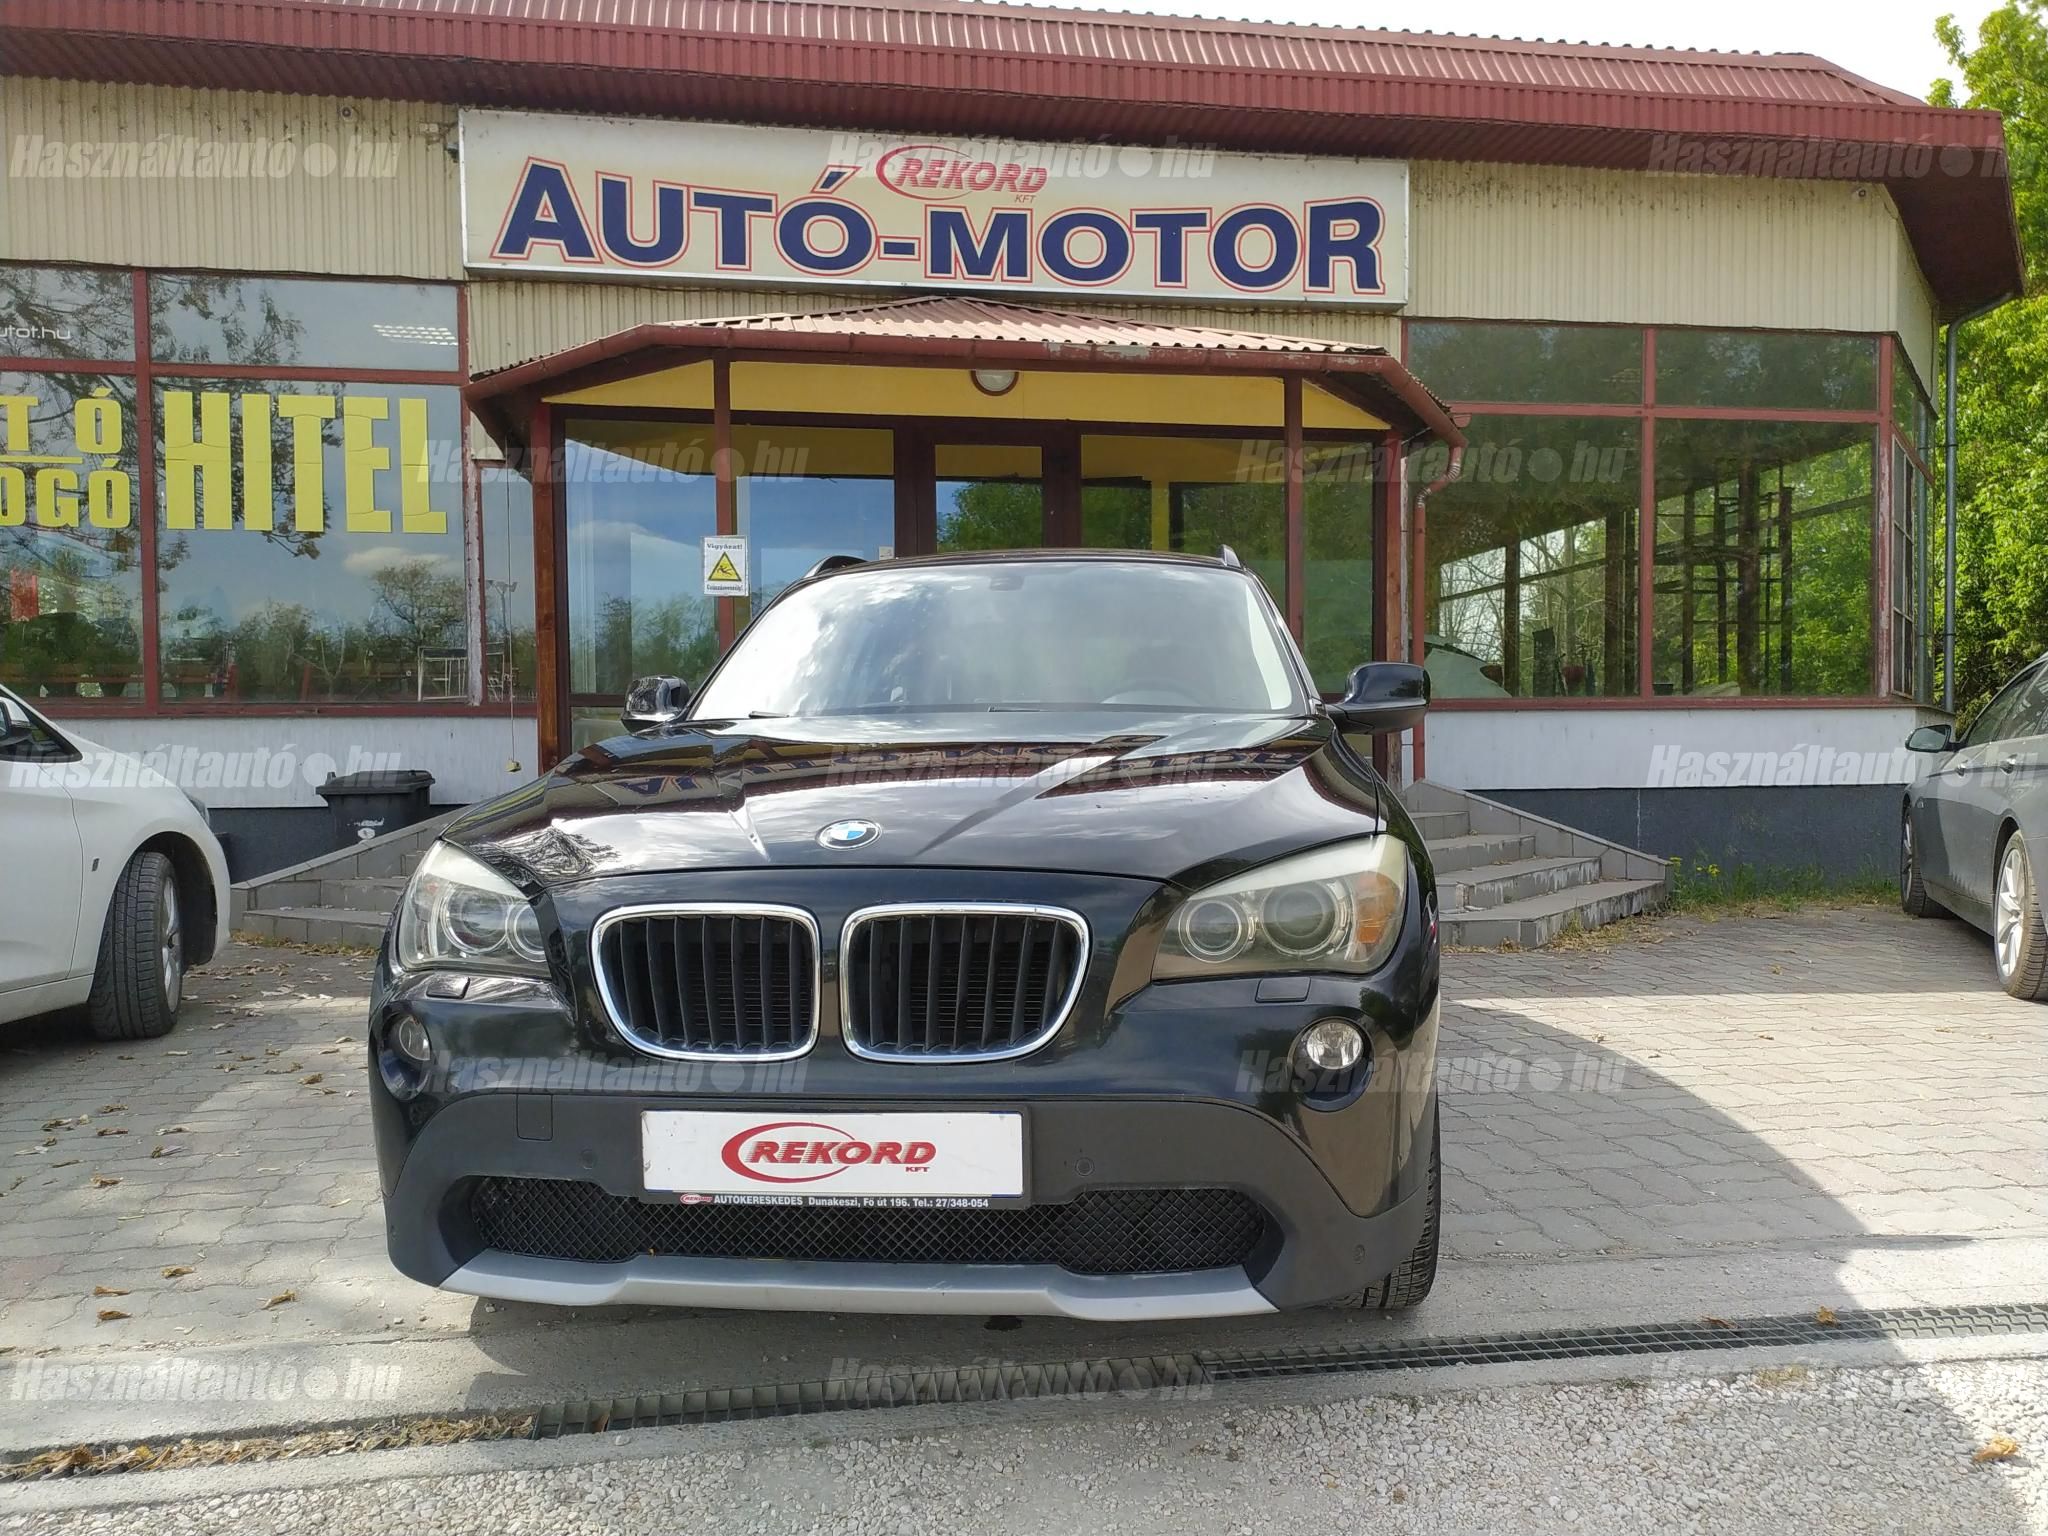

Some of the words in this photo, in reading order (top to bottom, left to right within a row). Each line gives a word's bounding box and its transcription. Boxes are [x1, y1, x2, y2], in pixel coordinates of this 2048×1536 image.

[894, 157, 1047, 194] REKORD
[1014, 194, 1036, 204] KFT
[491, 156, 1386, 295] AUTÓ-MOTOR
[163, 391, 448, 534] HITEL
[746, 1141, 936, 1164] REKORD
[808, 1197, 861, 1208] Dunakeszi,
[890, 1198, 911, 1207] 196.
[914, 1199, 933, 1208] Tel.:
[935, 1199, 989, 1208] 27/348-054
